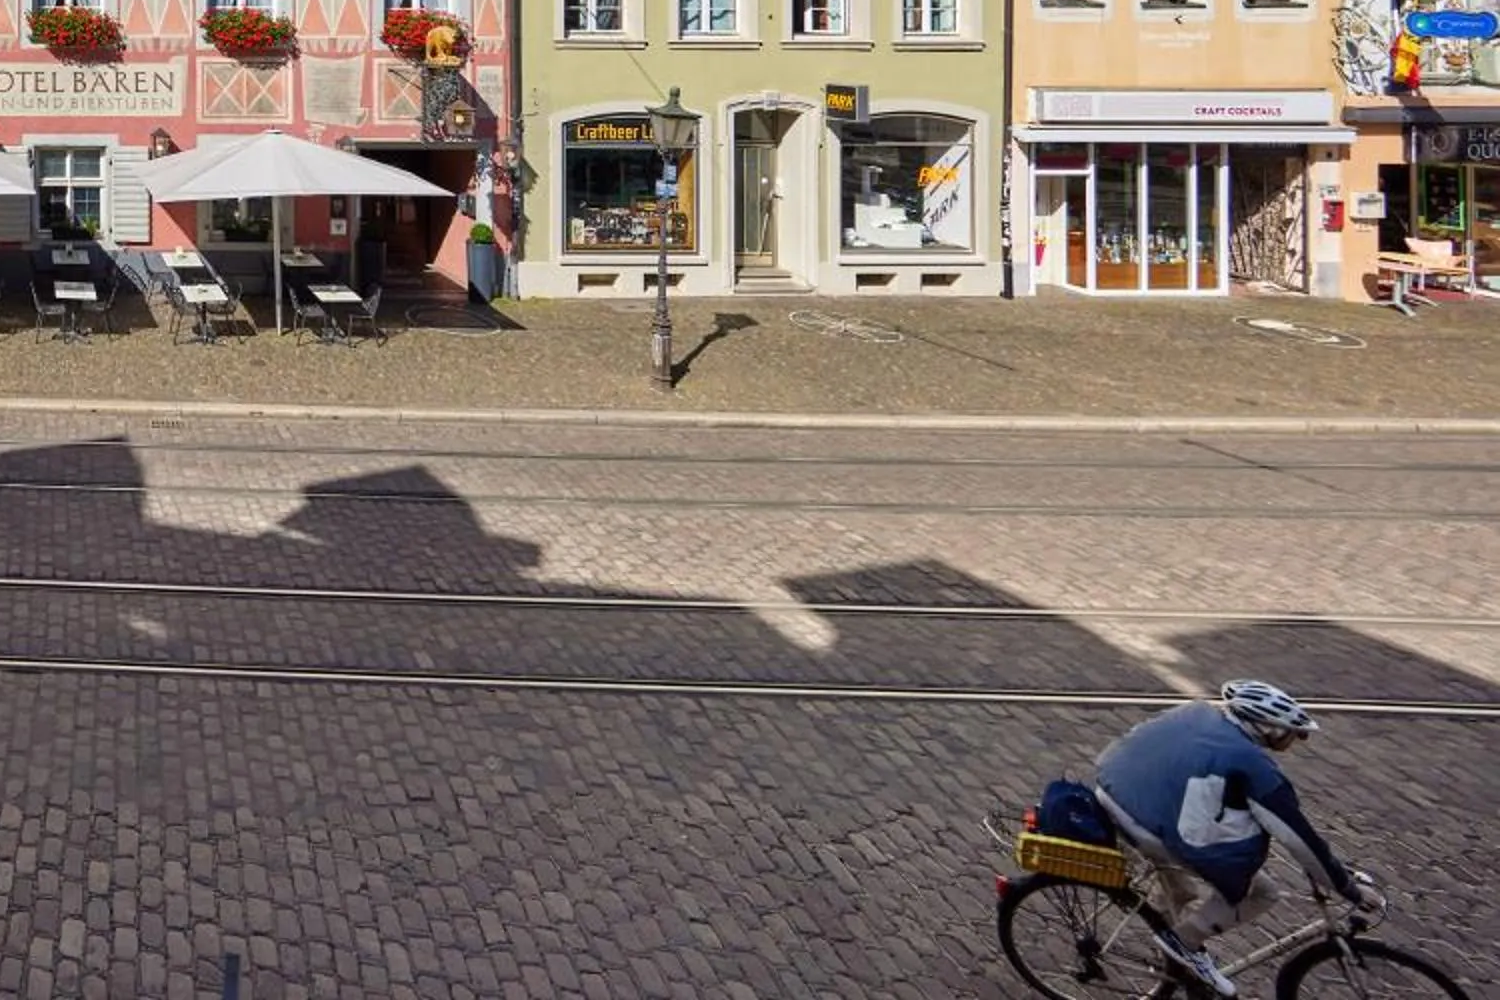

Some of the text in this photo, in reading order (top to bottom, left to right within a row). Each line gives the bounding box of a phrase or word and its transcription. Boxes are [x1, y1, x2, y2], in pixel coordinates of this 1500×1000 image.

[73, 71, 174, 94] BÄREN
[1194, 107, 1282, 116] CRAFT COCKTAILS
[577, 123, 639, 139] Craftbeer
